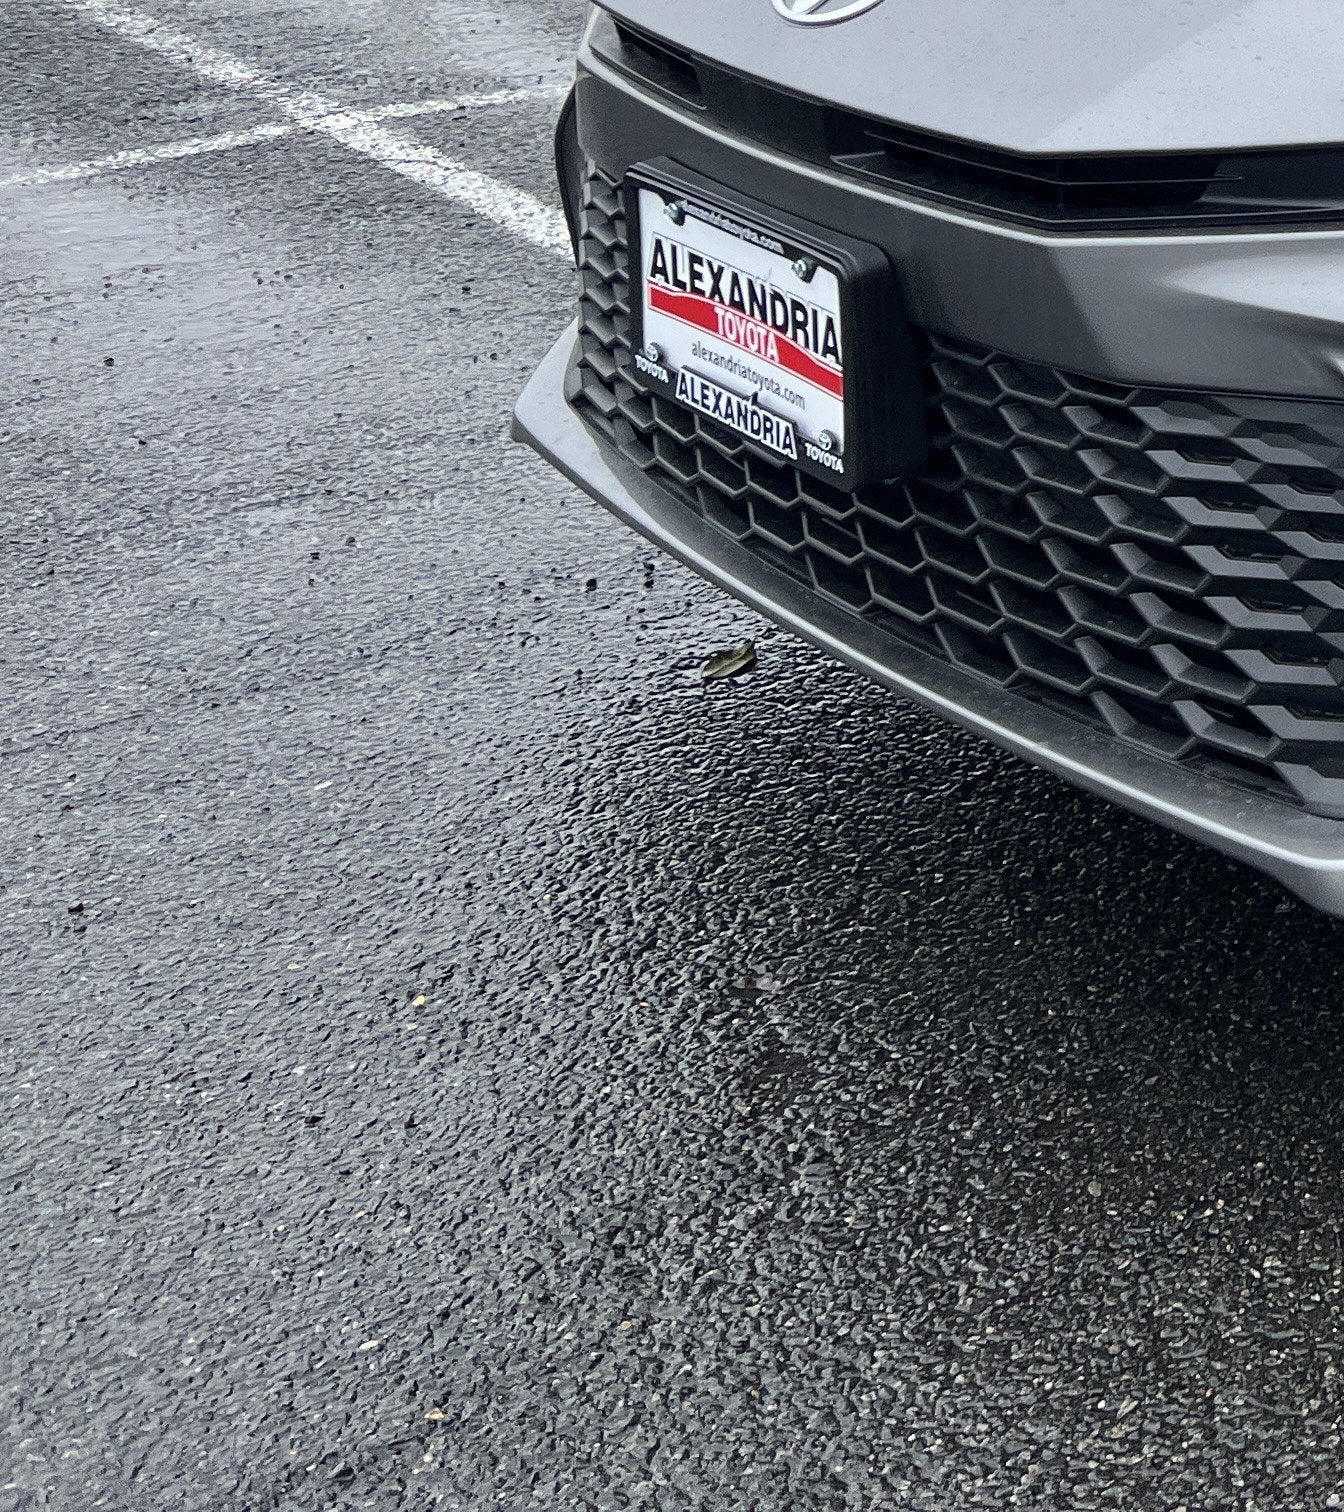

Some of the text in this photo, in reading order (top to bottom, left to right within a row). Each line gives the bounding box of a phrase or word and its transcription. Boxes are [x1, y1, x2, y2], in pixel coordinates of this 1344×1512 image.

[650, 237, 840, 363] ALEXANDRIA
[713, 305, 781, 363] TOYOTA
[635, 354, 669, 384] TOYOTA
[691, 340, 806, 411] alexandriatoyota.com
[676, 369, 797, 460] ALEXANDRIA
[804, 442, 845, 474] TOYOTA
